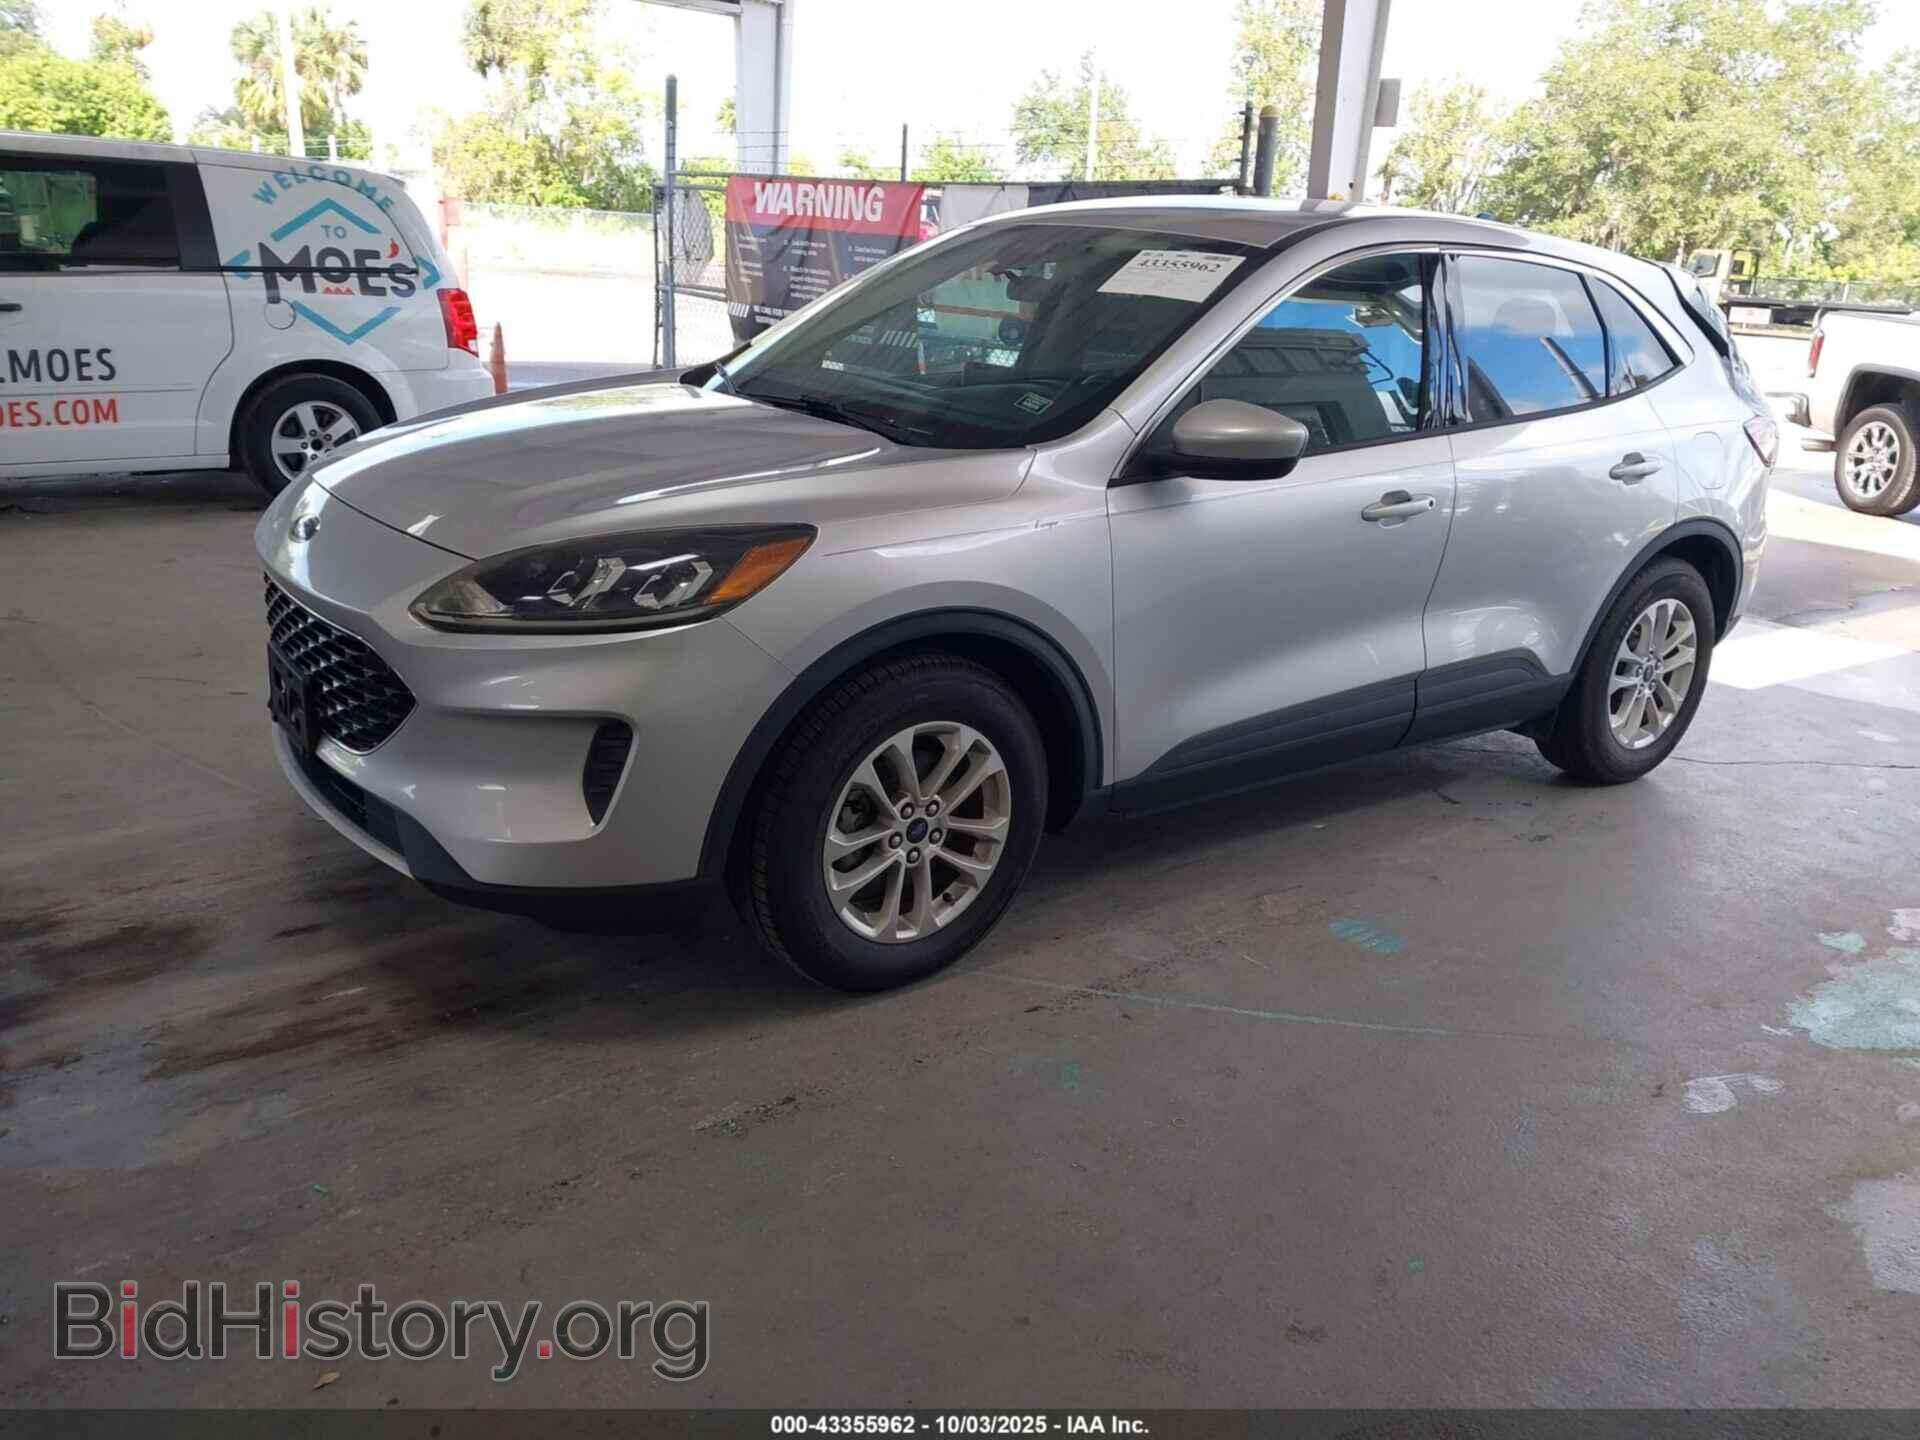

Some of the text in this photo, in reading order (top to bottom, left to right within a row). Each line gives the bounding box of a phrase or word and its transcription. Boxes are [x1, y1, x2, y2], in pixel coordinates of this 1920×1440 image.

[253, 165, 395, 210] WELCOME
[754, 181, 885, 223] WARNING
[320, 224, 347, 239] TO
[0, 398, 119, 428] ES.COM
